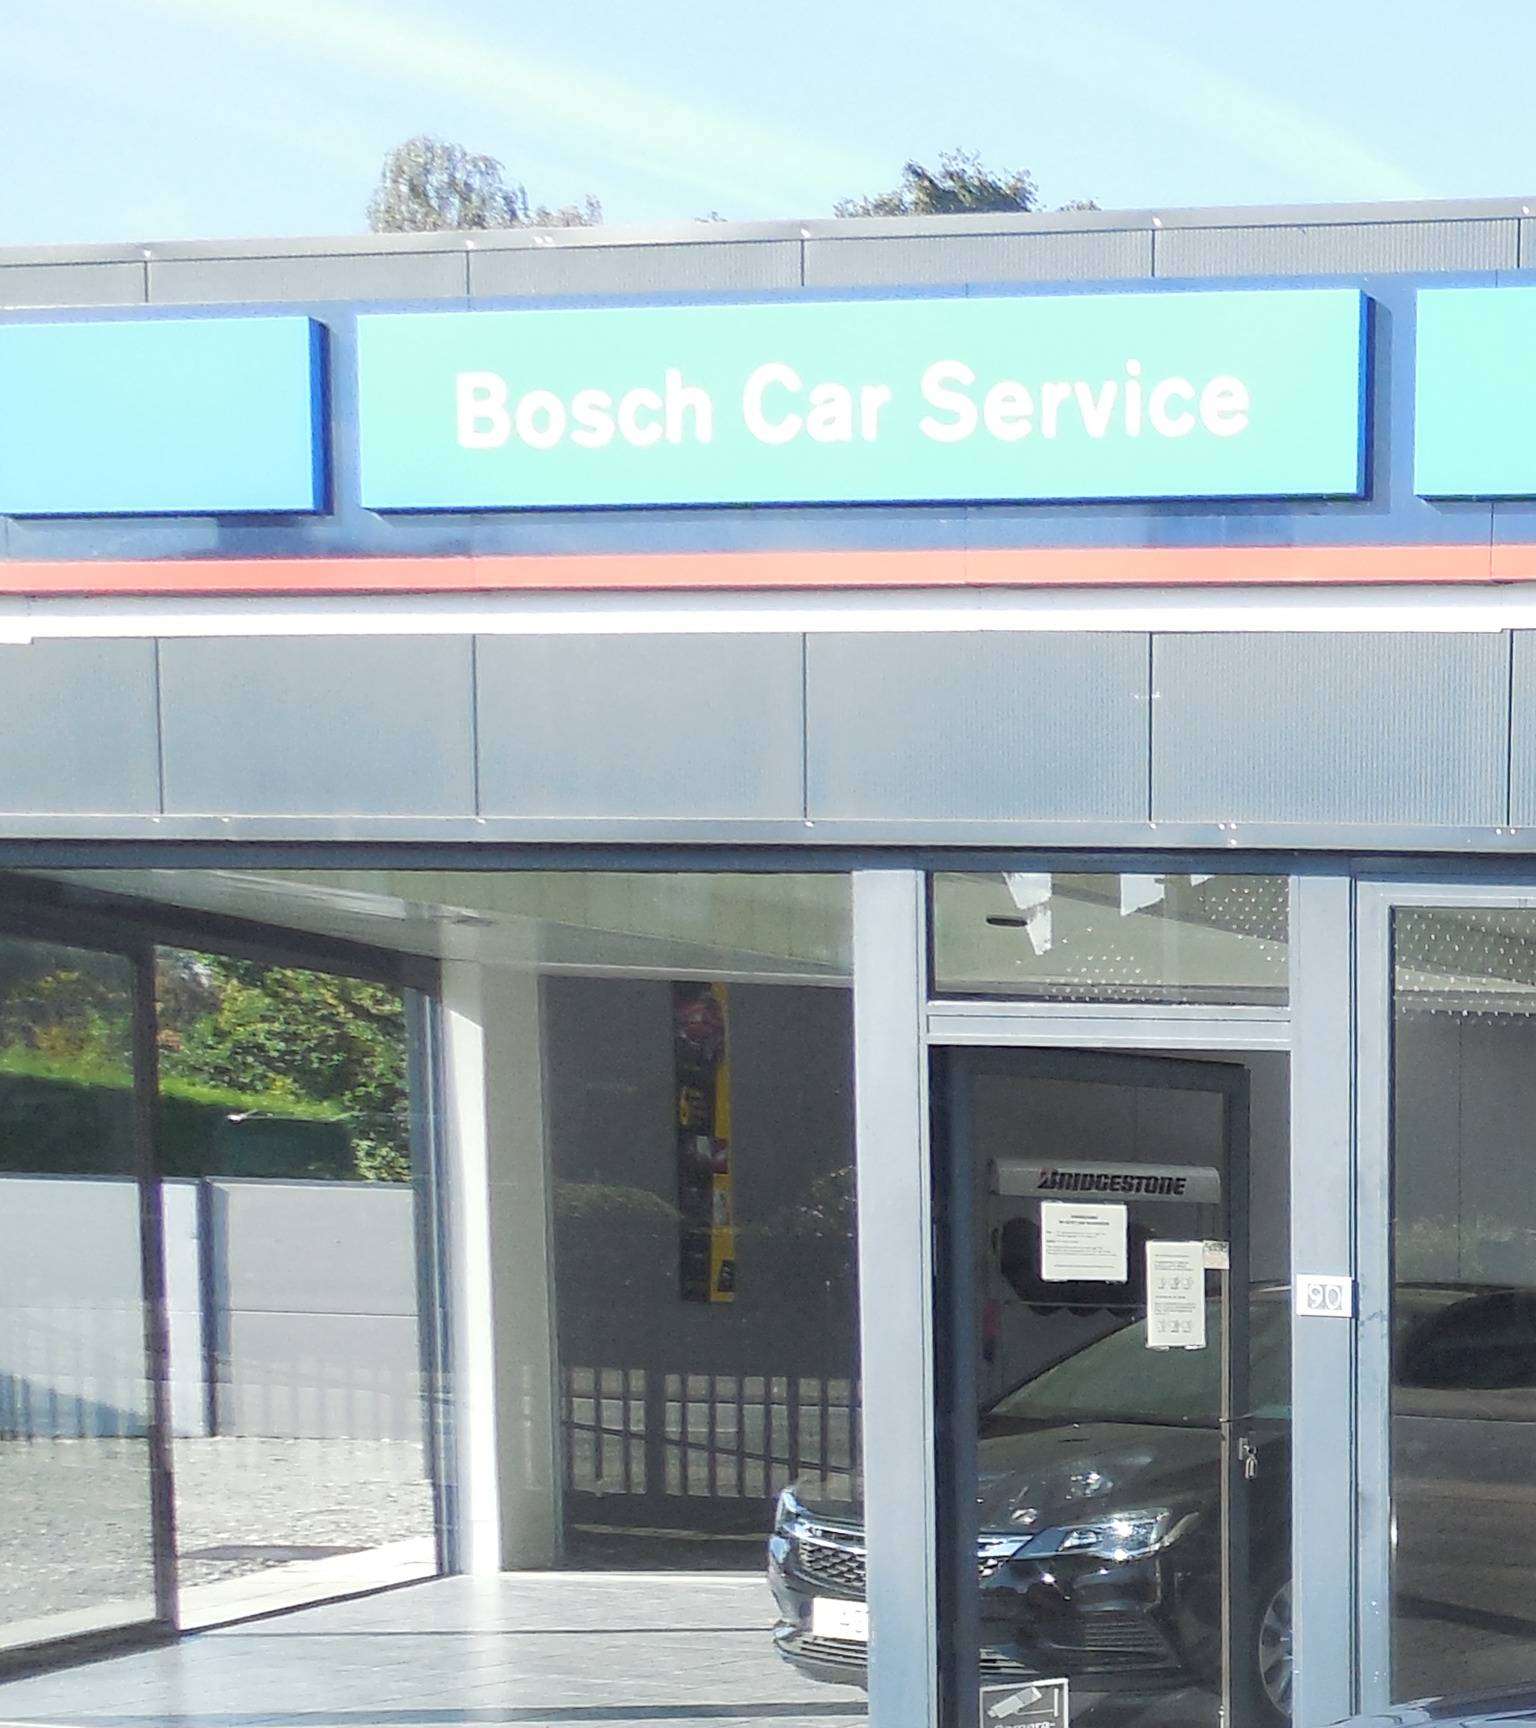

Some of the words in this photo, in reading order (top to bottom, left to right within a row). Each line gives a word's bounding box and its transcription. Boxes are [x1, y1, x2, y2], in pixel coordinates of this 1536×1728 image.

[455, 368, 713, 449] Bosch
[741, 362, 892, 445] Car
[918, 359, 1252, 443] Service
[1038, 1168, 1187, 1195] BRIDGESTONE
